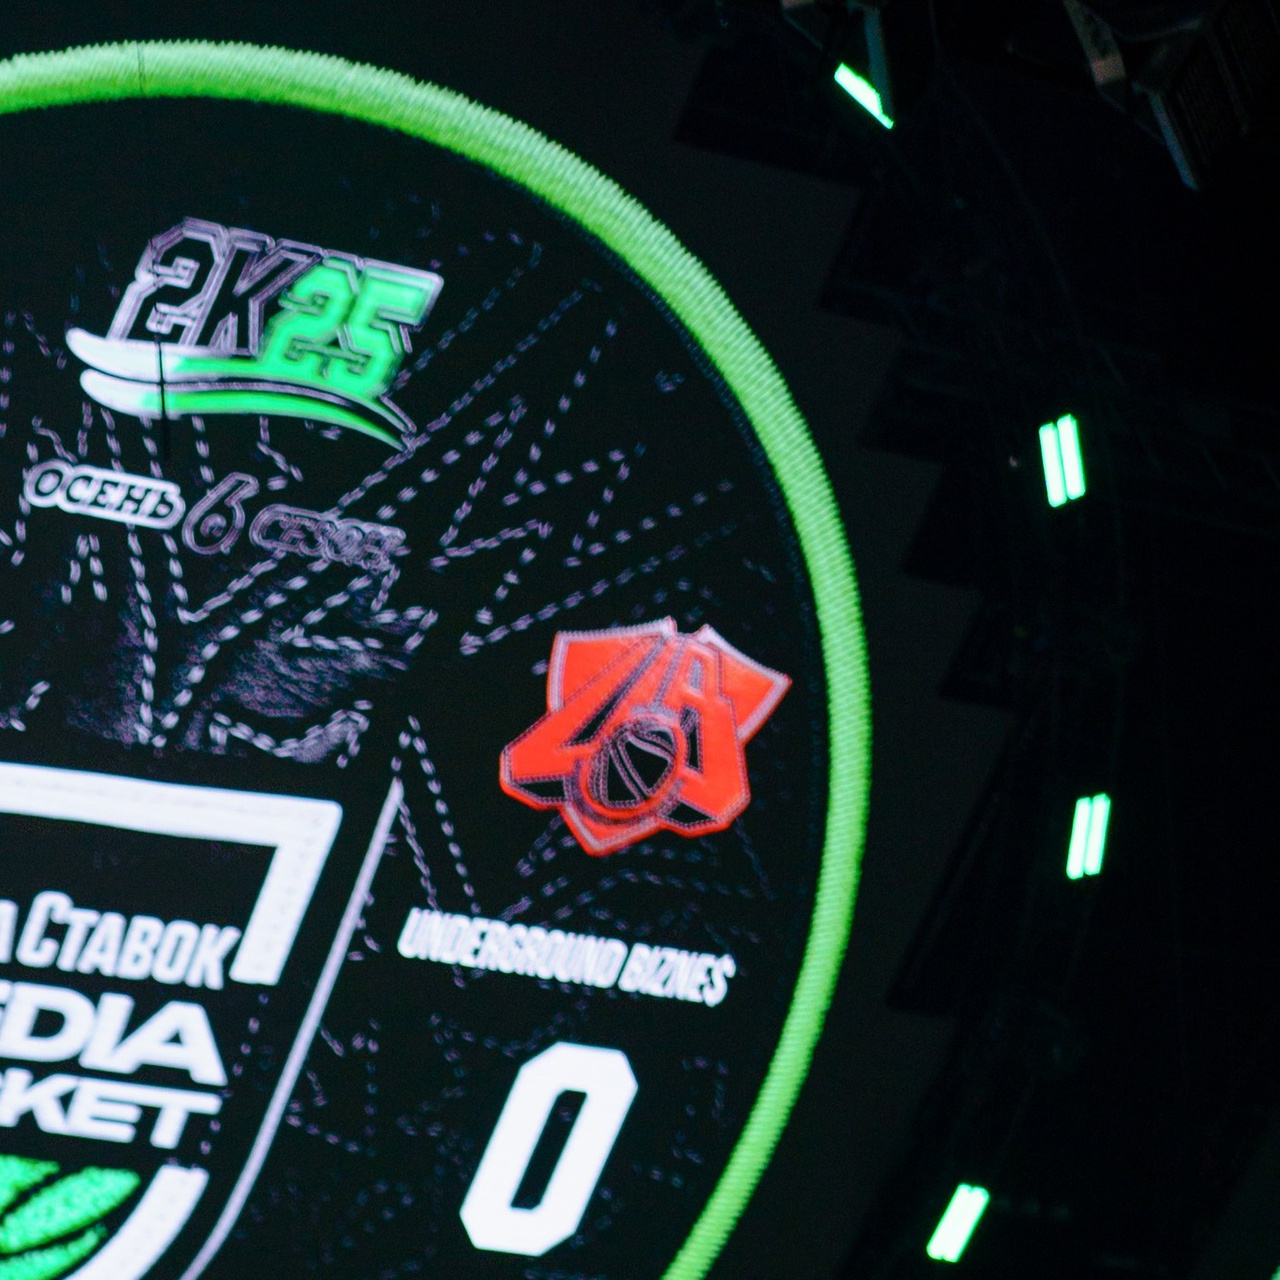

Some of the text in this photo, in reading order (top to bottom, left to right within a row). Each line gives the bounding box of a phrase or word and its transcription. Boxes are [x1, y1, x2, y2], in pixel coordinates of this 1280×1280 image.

[104, 215, 444, 398] 2K25
[16, 890, 241, 990] СТАВОК
[397, 907, 628, 988] UNDERGROUND
[459, 1041, 639, 1257] 0
